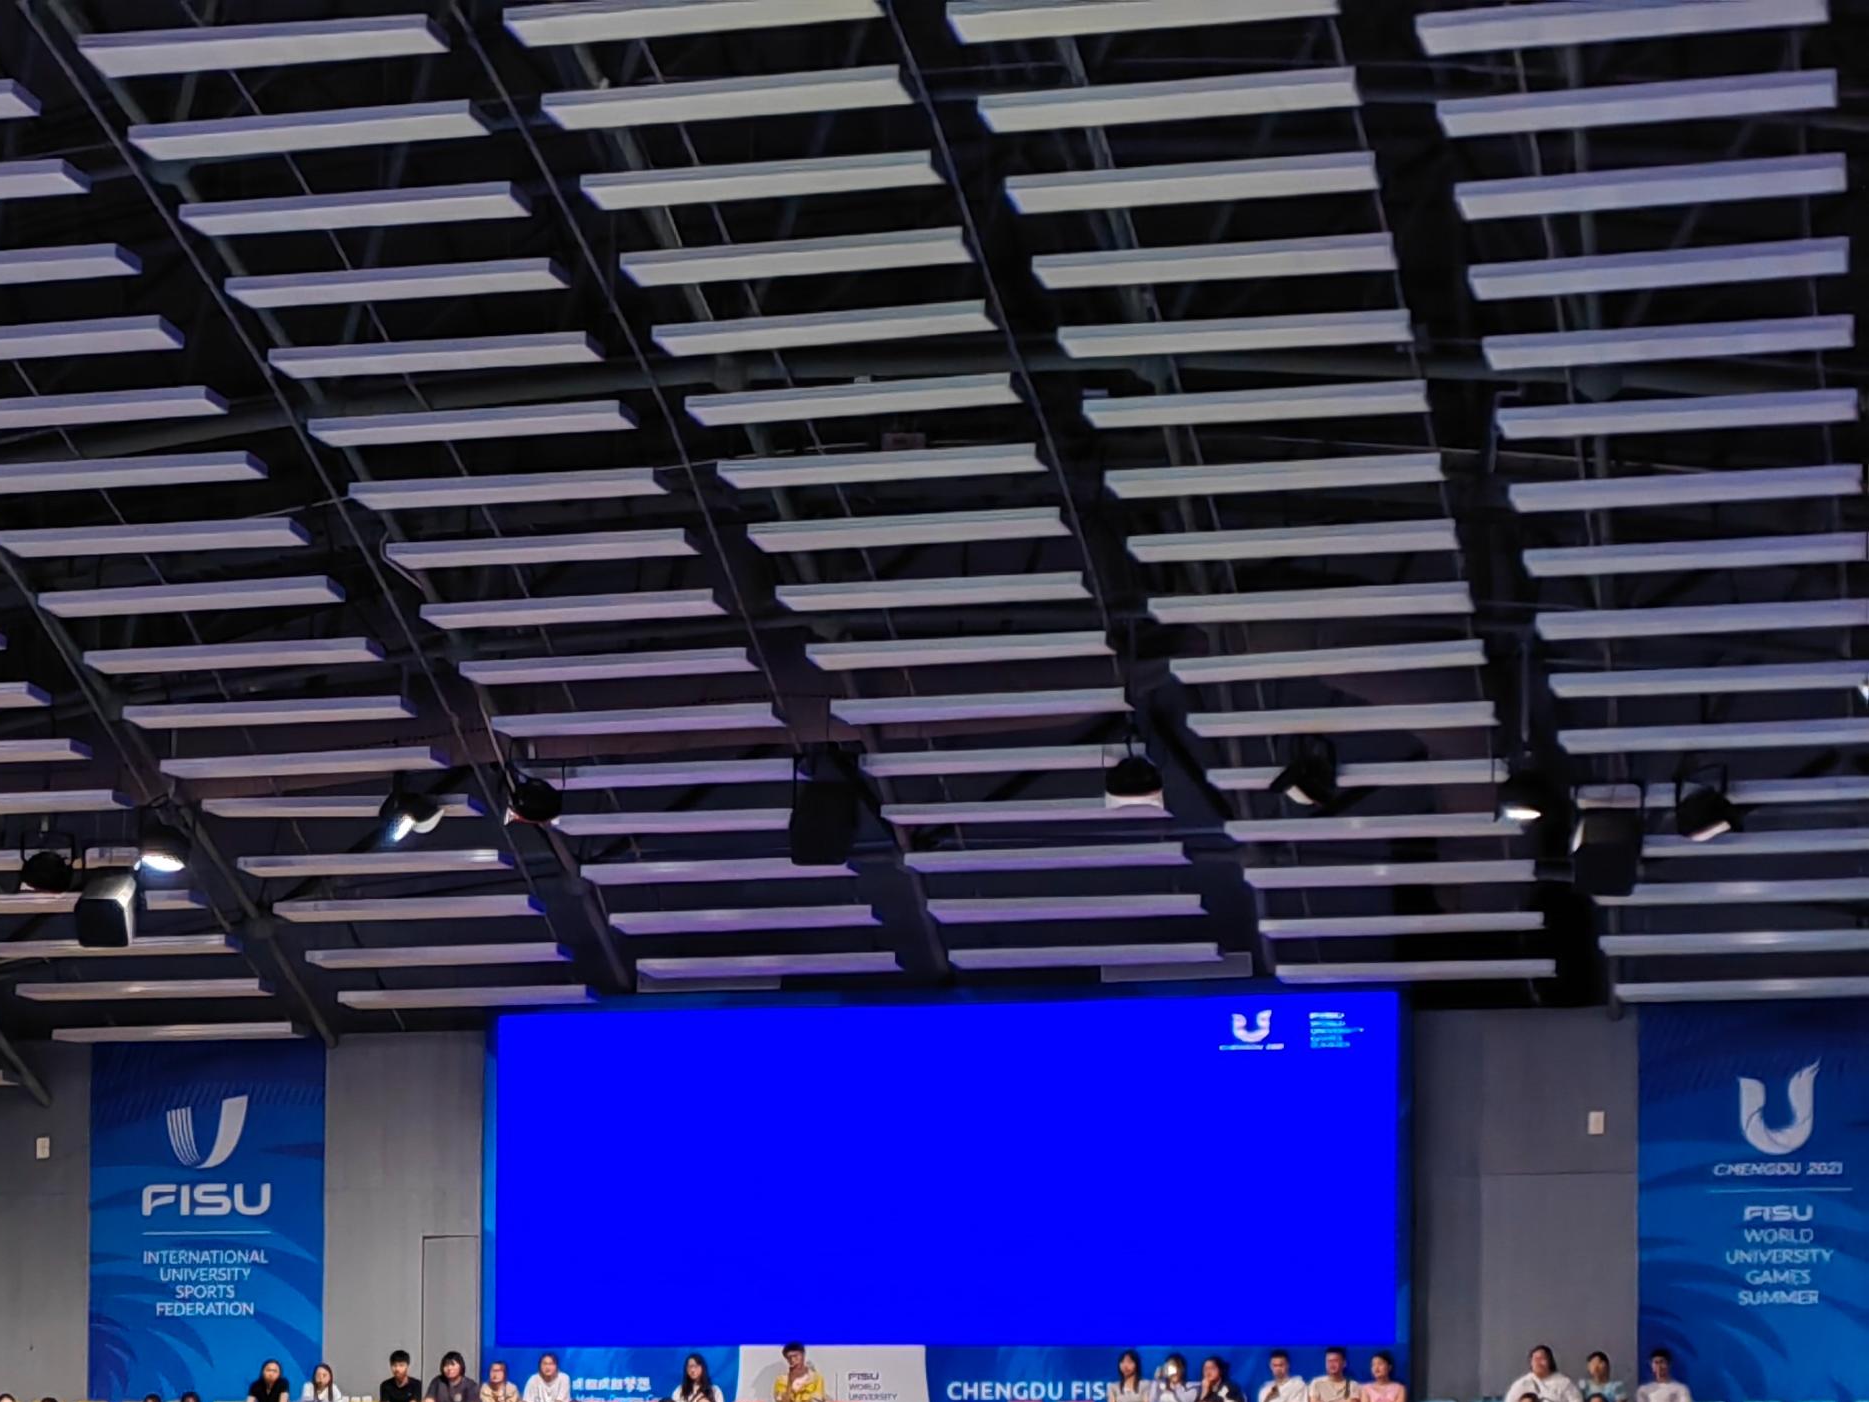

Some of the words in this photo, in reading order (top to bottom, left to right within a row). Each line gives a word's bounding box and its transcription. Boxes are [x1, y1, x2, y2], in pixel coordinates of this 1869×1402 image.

[141, 1183, 272, 1217] FISU
[1743, 1205, 1813, 1222] FISU
[1744, 1228, 1813, 1243] WORLD
[142, 1249, 269, 1265] INTERNATIONAL
[1726, 1248, 1834, 1265] UNIVERSITY
[159, 1267, 251, 1282] UNIVERSITY
[1745, 1269, 1811, 1286] GAMES
[175, 1285, 235, 1299] SPORTS
[1738, 1289, 1819, 1306] SUMMER
[156, 1302, 254, 1317] FEDERATION
[946, 1381, 1063, 1401] CHENGDU
[1071, 1381, 1106, 1401] FIS
